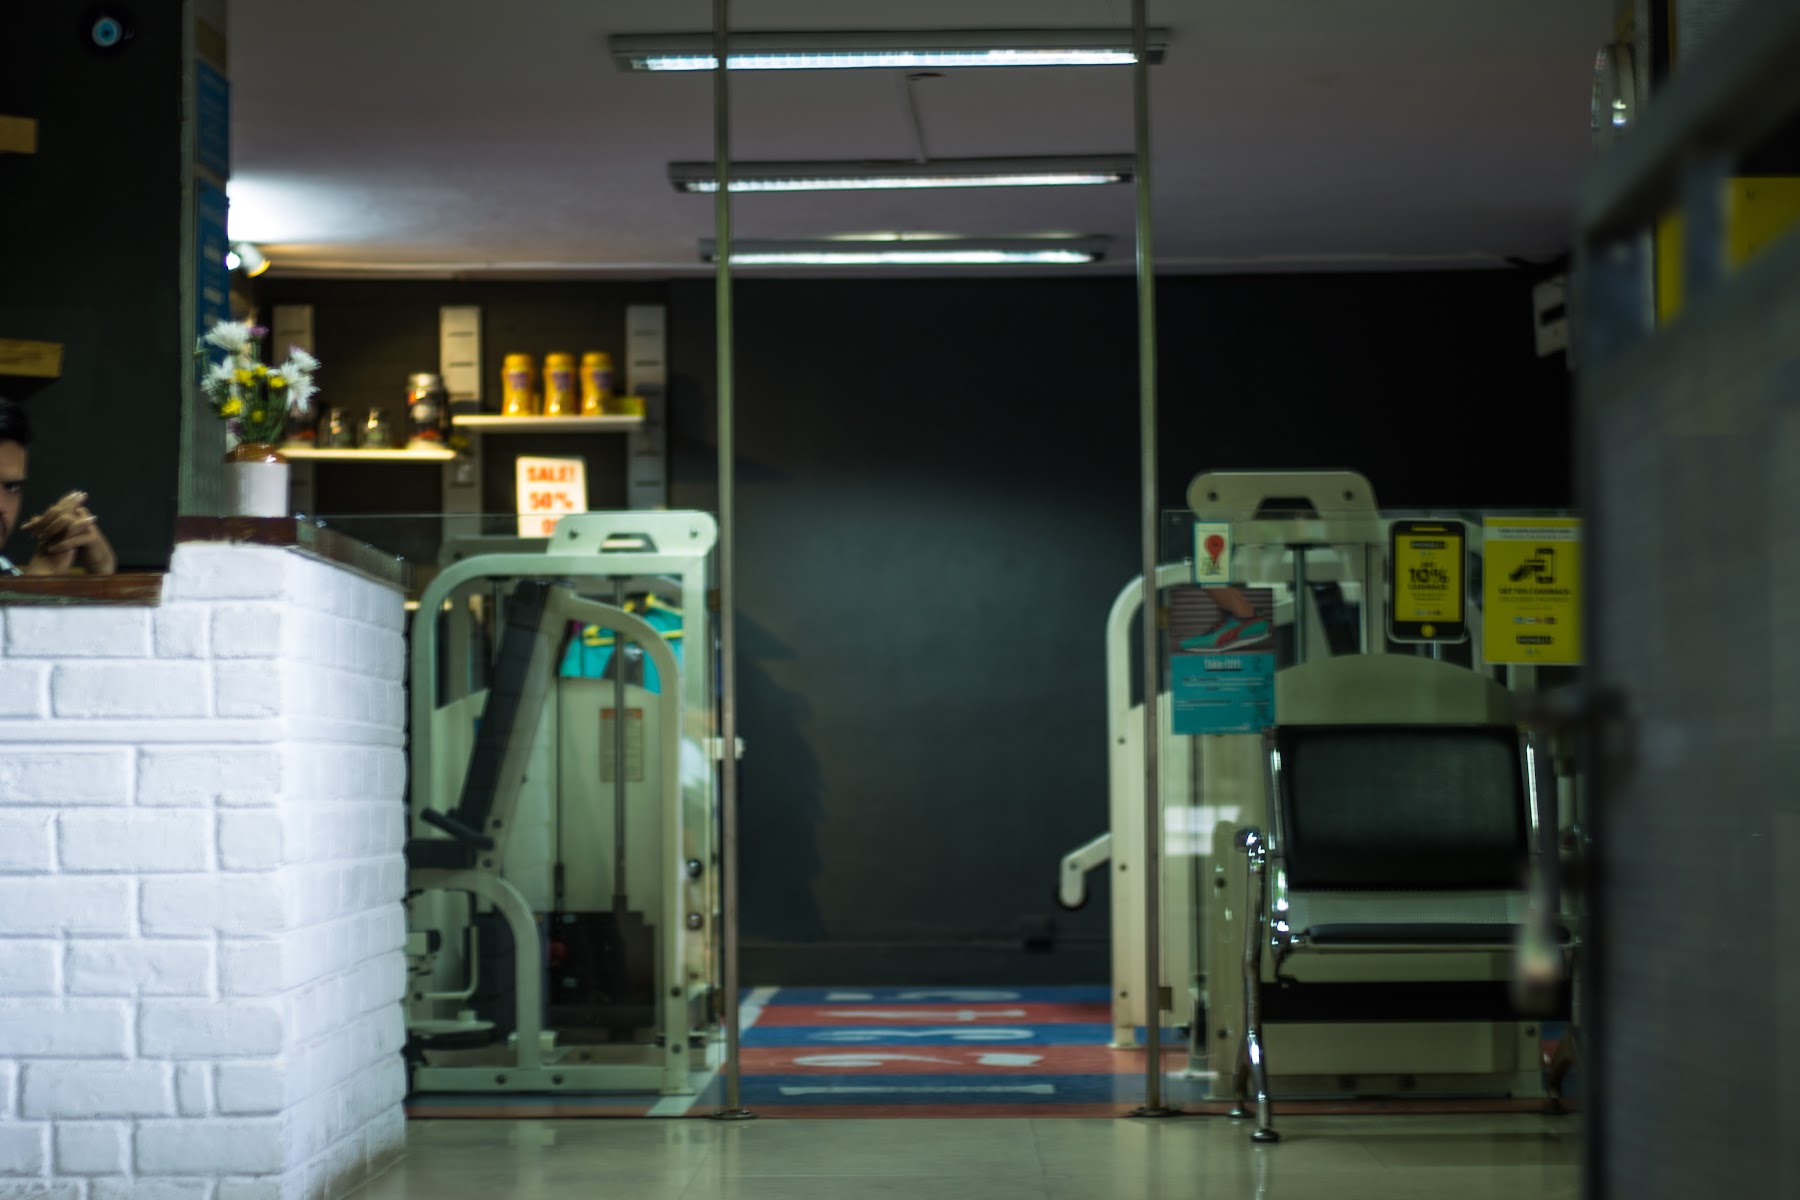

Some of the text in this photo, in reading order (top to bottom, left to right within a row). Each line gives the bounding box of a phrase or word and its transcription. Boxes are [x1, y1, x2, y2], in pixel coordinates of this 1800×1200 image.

[527, 466, 574, 482] SALE!
[530, 491, 573, 509] 50%
[1408, 567, 1449, 583] 10%
